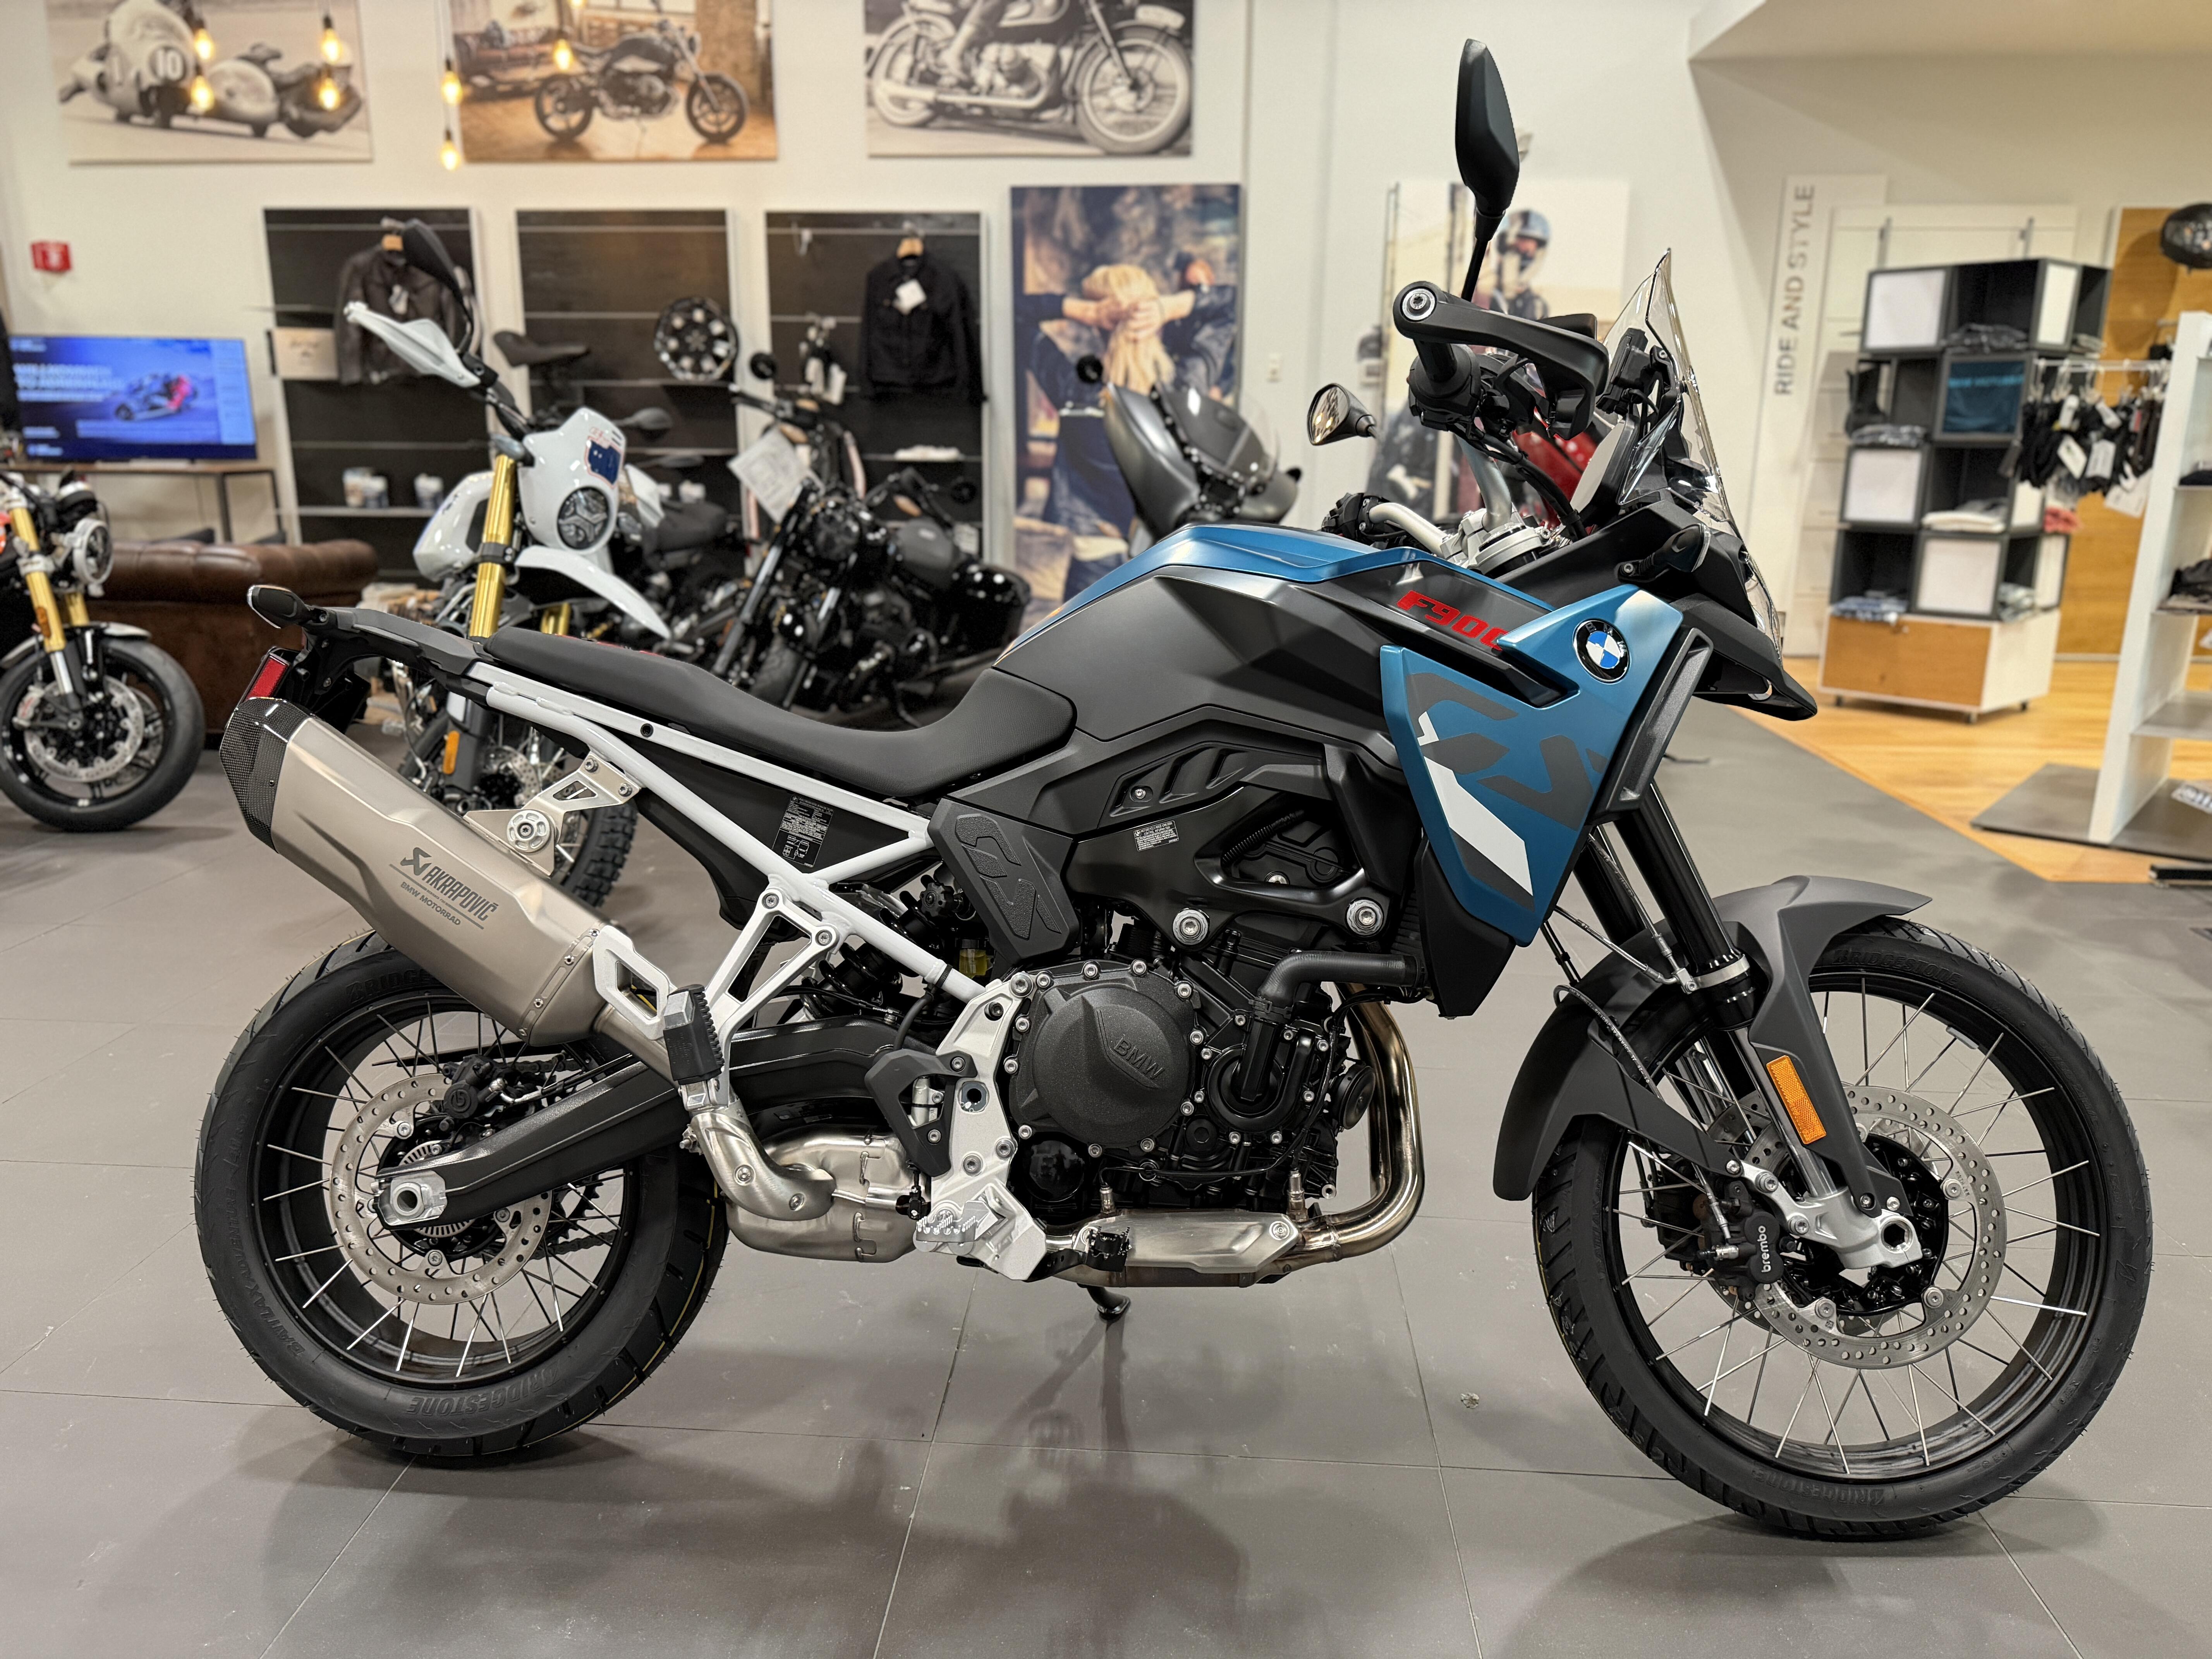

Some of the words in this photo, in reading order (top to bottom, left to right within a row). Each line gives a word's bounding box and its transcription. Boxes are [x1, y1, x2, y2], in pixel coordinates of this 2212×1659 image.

[1788, 185, 1815, 270] STYLE
[1782, 275, 1805, 330] AND
[1775, 337, 1796, 395] RIDE
[400, 881, 420, 897] BMW
[420, 895, 461, 926] MOTORRAD
[1832, 950, 1963, 986] BRIDGESTONE
[1114, 1037, 1165, 1080] BMW
[1757, 1225, 1771, 1273] brembo
[246, 1284, 305, 1357] BATTLAX
[407, 1362, 562, 1416] BRIDGESTONE
[1752, 1470, 1885, 1506] BRIDGESTONE
